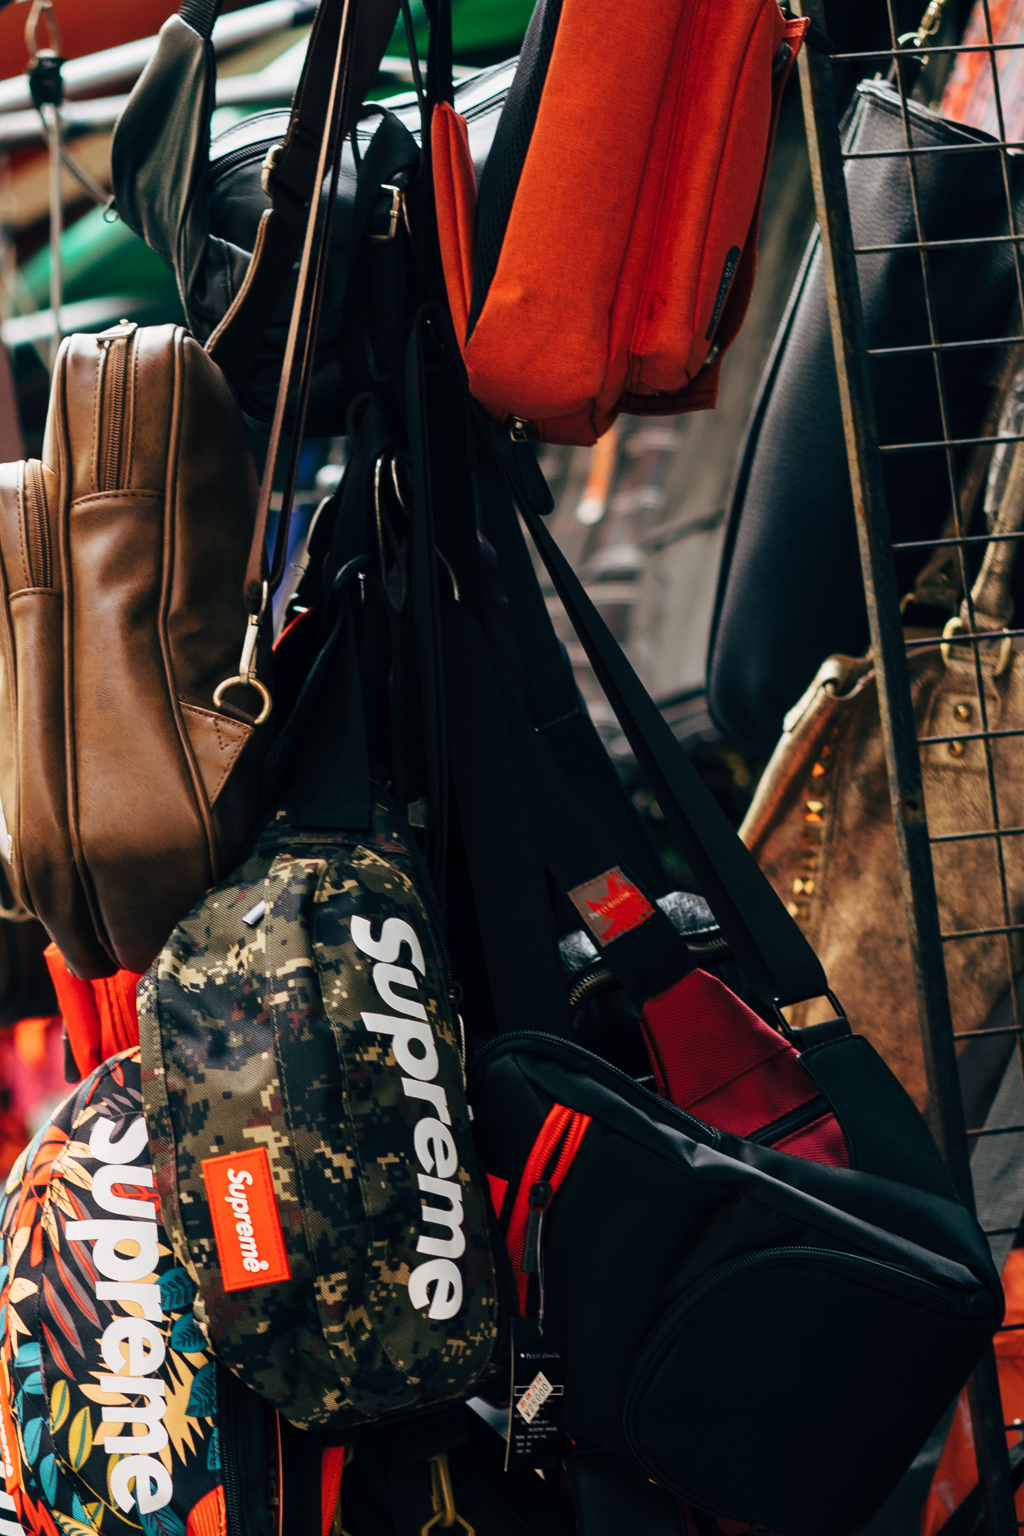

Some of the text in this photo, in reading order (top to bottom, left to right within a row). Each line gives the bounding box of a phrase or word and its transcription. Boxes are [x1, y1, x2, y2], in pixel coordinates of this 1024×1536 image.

[65, 1115, 173, 1515] Supreme
[225, 1168, 268, 1273] Supreme
[350, 914, 466, 1321] Supreme
